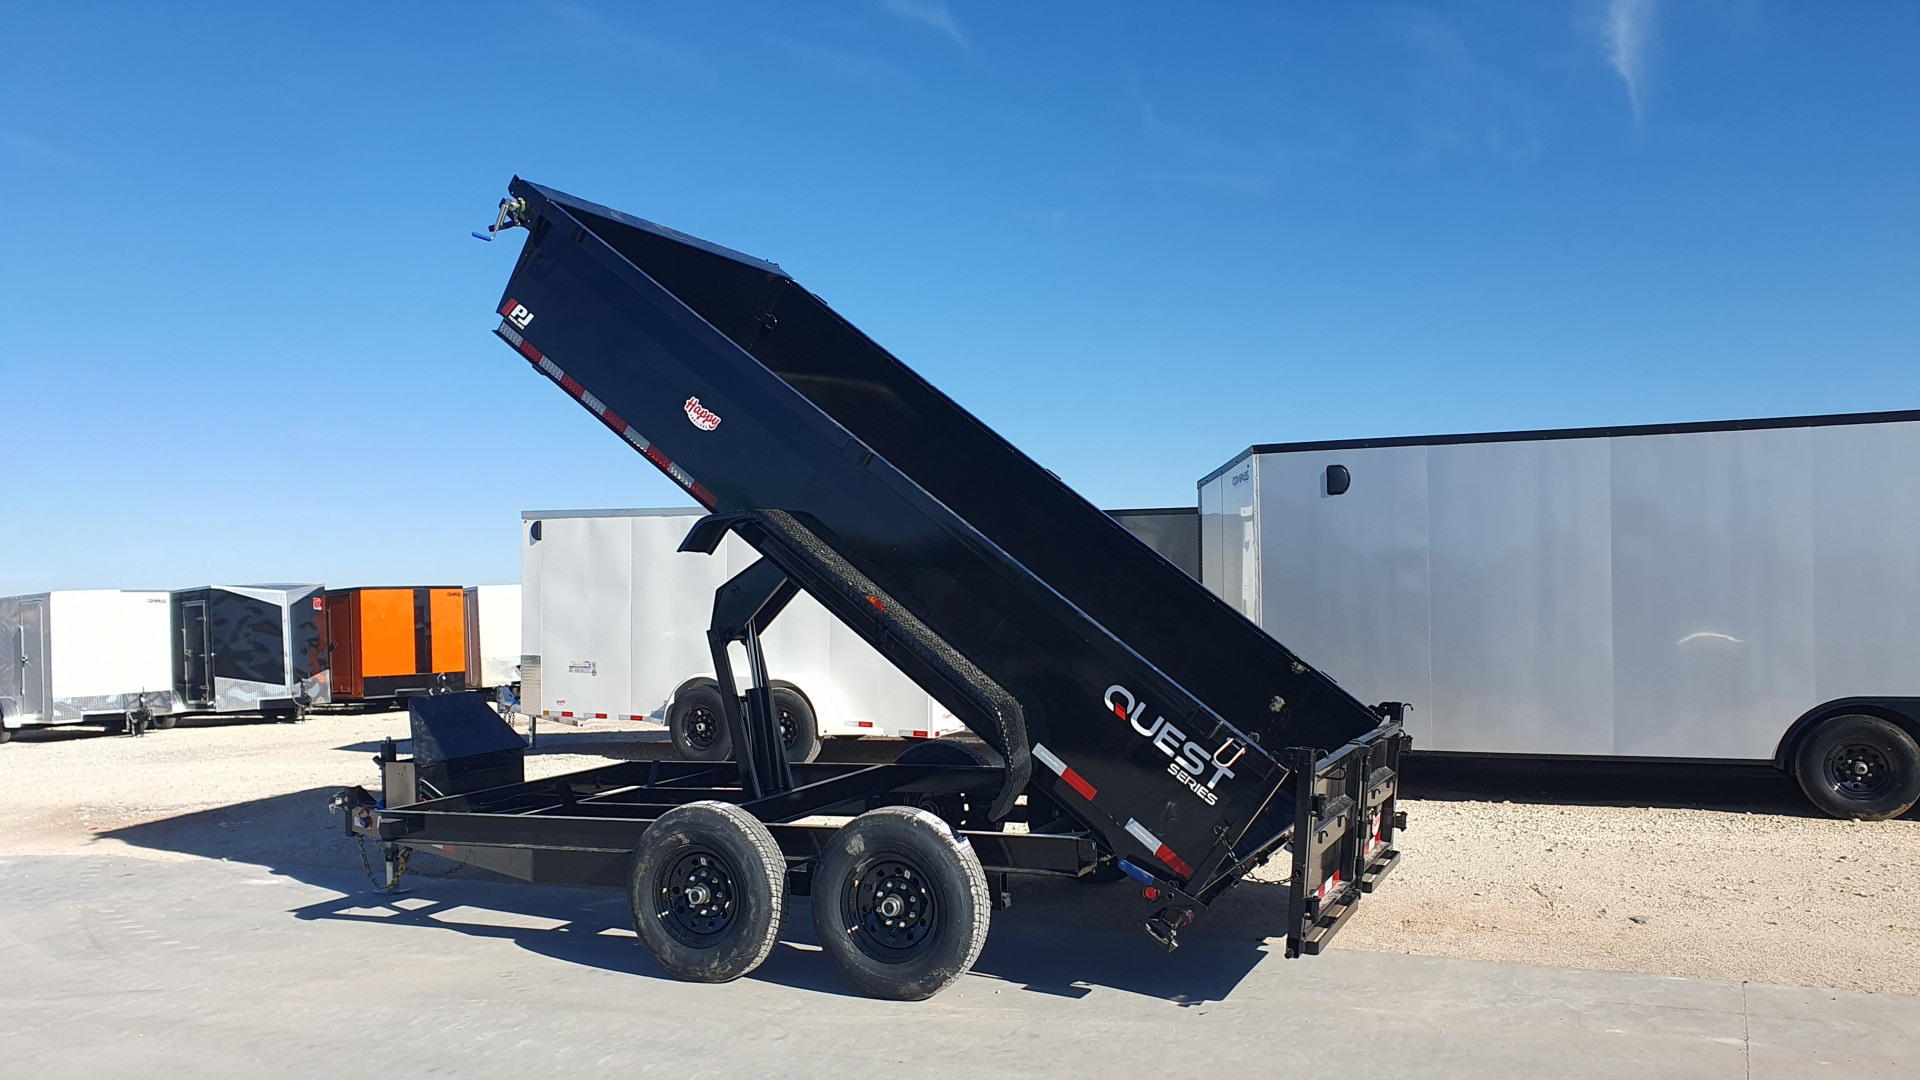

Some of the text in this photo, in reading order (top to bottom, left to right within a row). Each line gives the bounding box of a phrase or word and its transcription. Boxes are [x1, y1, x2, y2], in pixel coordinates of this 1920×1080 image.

[510, 303, 535, 327] PJ
[685, 397, 720, 429] Happy
[1104, 684, 1235, 790] QUEST
[1167, 762, 1218, 806] SERIES
